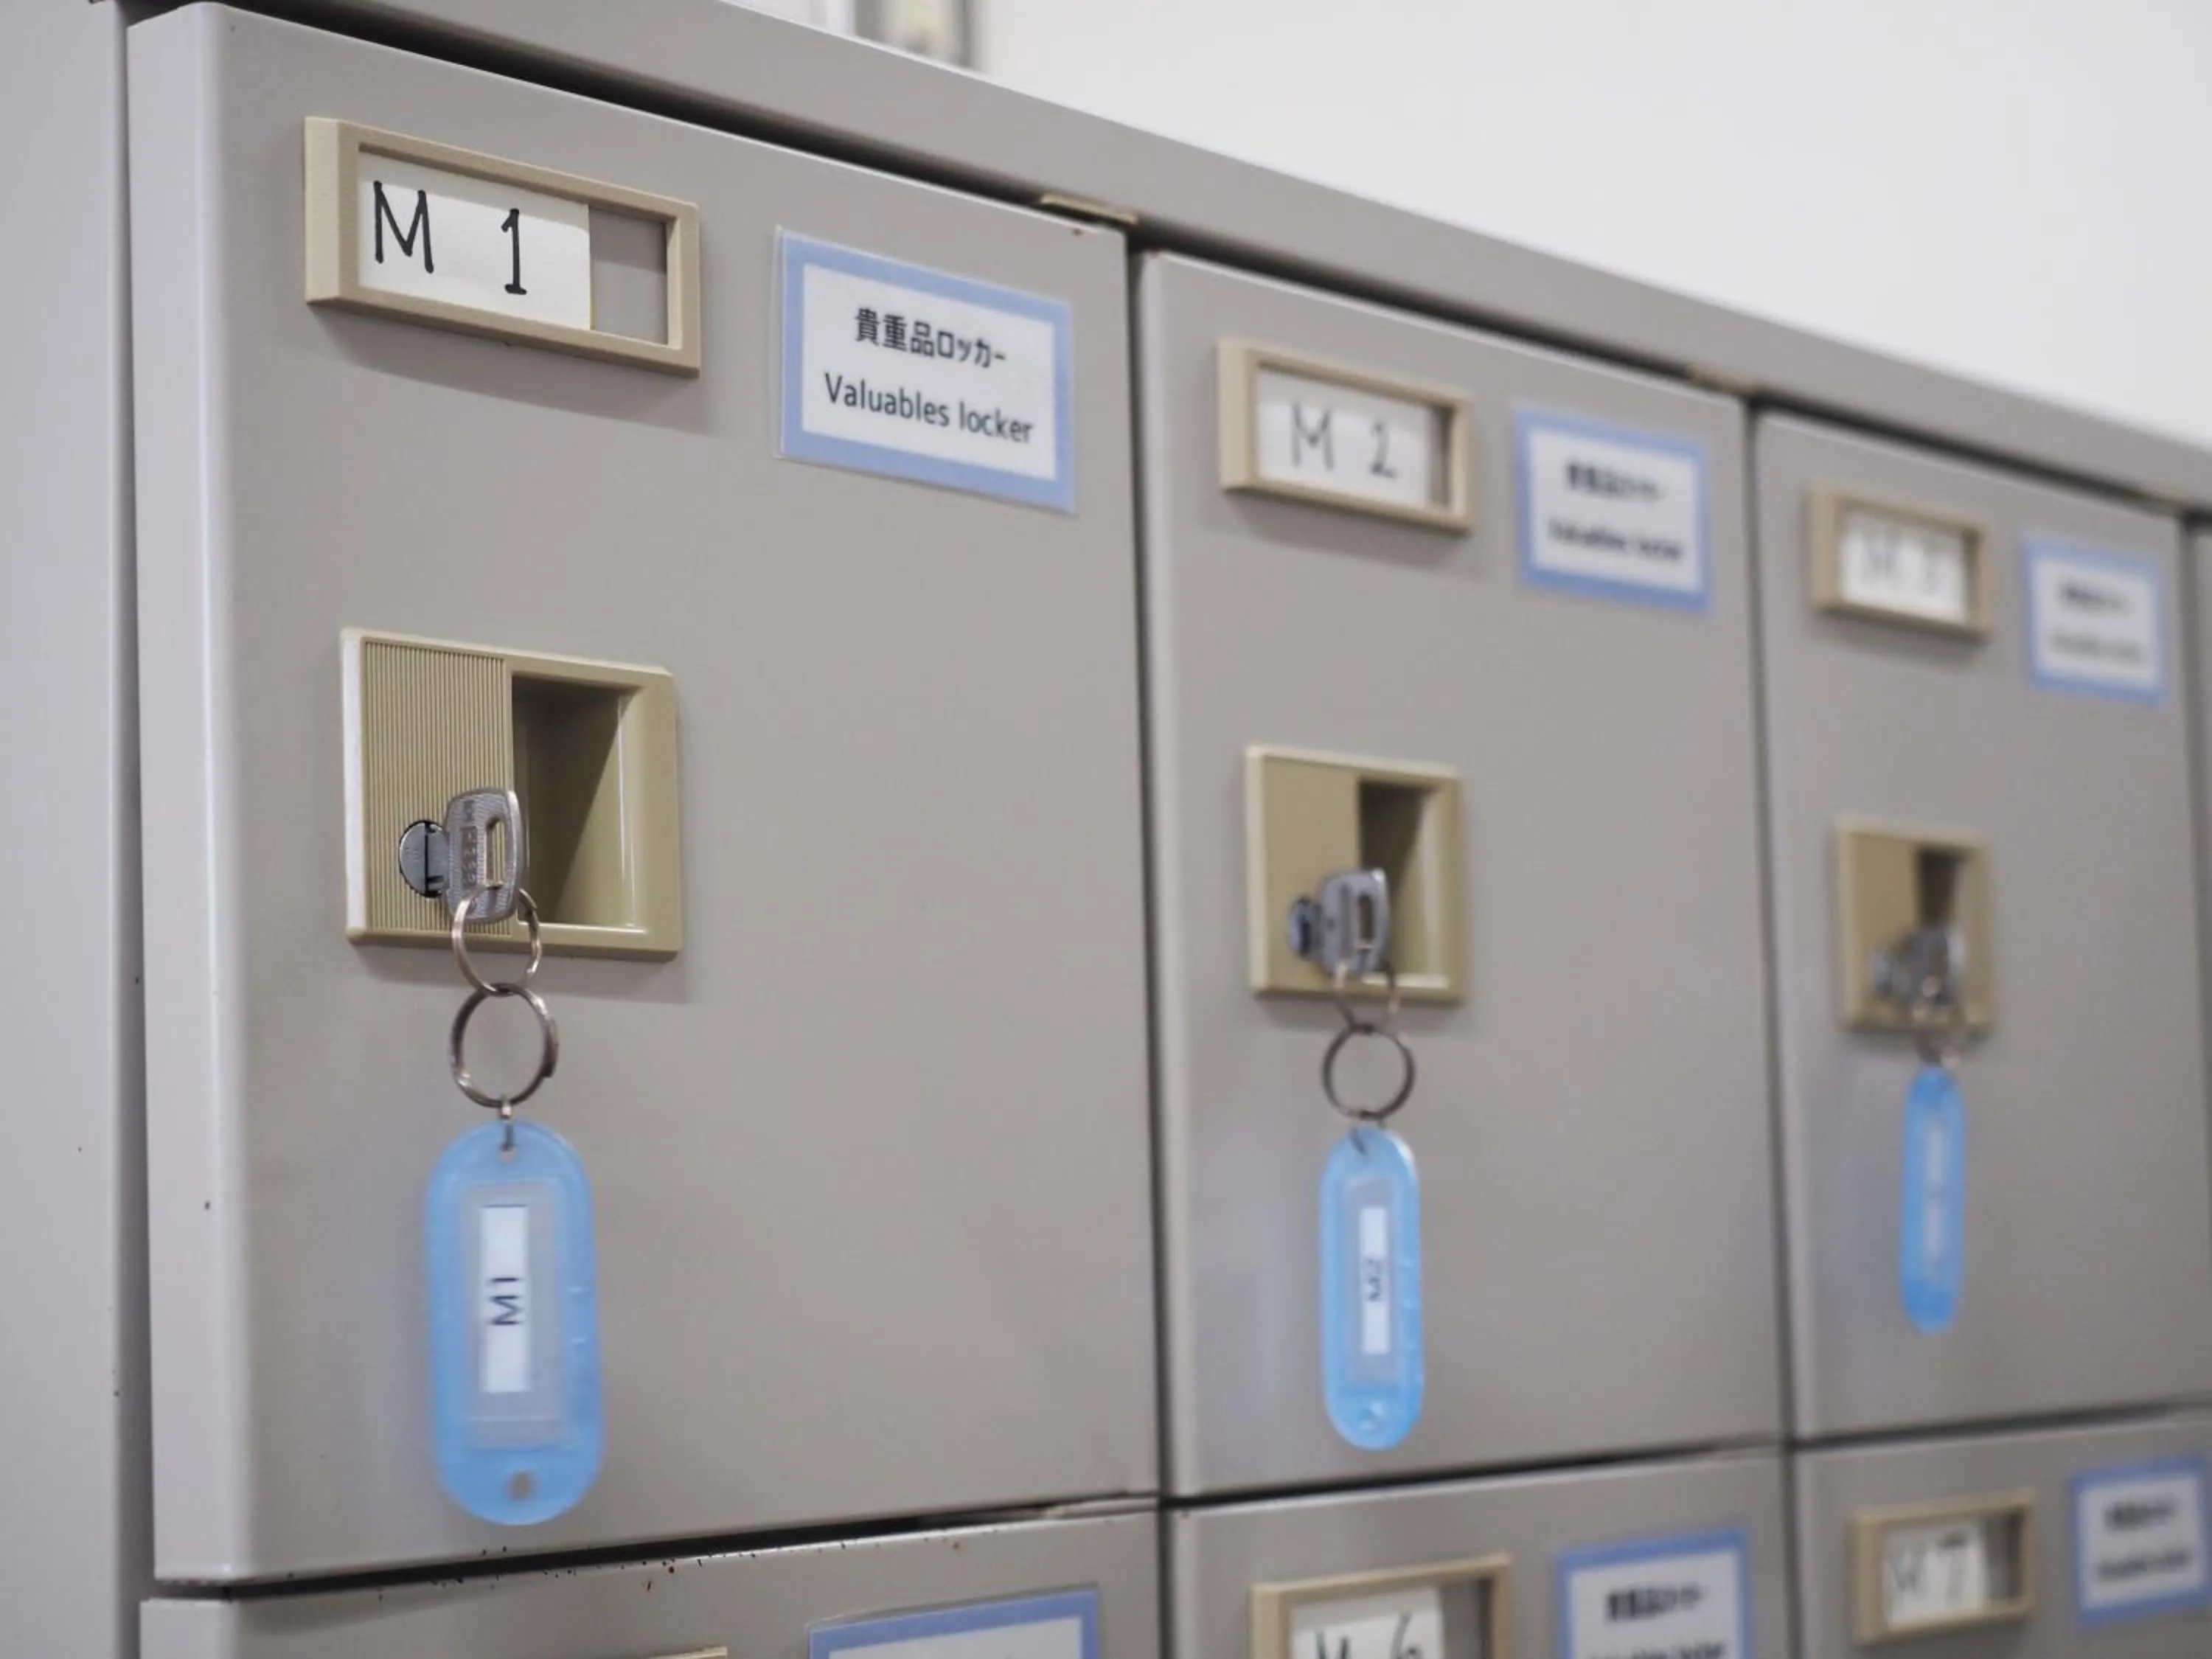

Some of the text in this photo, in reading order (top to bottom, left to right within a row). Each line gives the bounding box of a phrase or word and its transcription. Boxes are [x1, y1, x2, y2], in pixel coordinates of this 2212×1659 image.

[373, 180, 527, 295] M 1
[854, 307, 1006, 369] 貴重品ロッカー
[824, 372, 1034, 444] Valuables locker
[1290, 402, 1399, 480] M 2
[490, 1276, 522, 1326] M1
